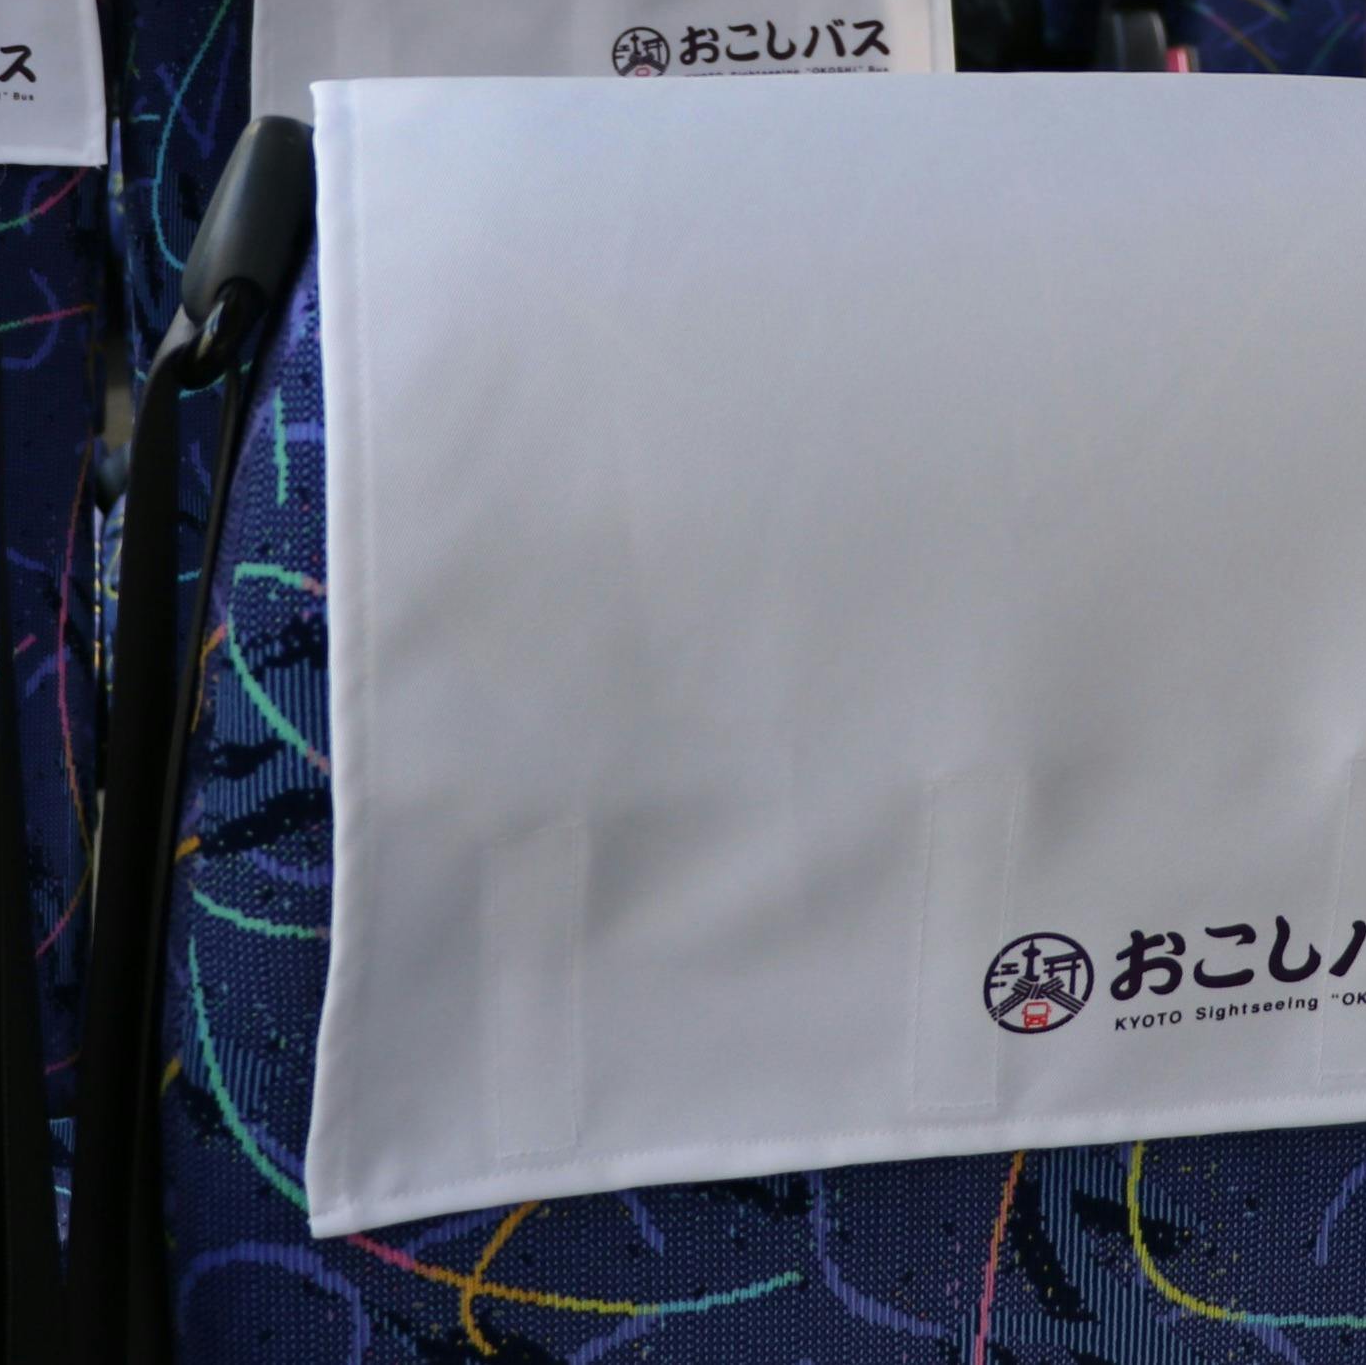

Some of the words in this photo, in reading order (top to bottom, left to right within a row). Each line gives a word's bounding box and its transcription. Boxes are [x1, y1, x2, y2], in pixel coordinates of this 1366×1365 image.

[679, 19, 890, 65] おこしバス
[12, 91, 35, 102] Bus
[1114, 1010, 1183, 1032] KYOTO
[1195, 995, 1319, 1023] Sightseeing
